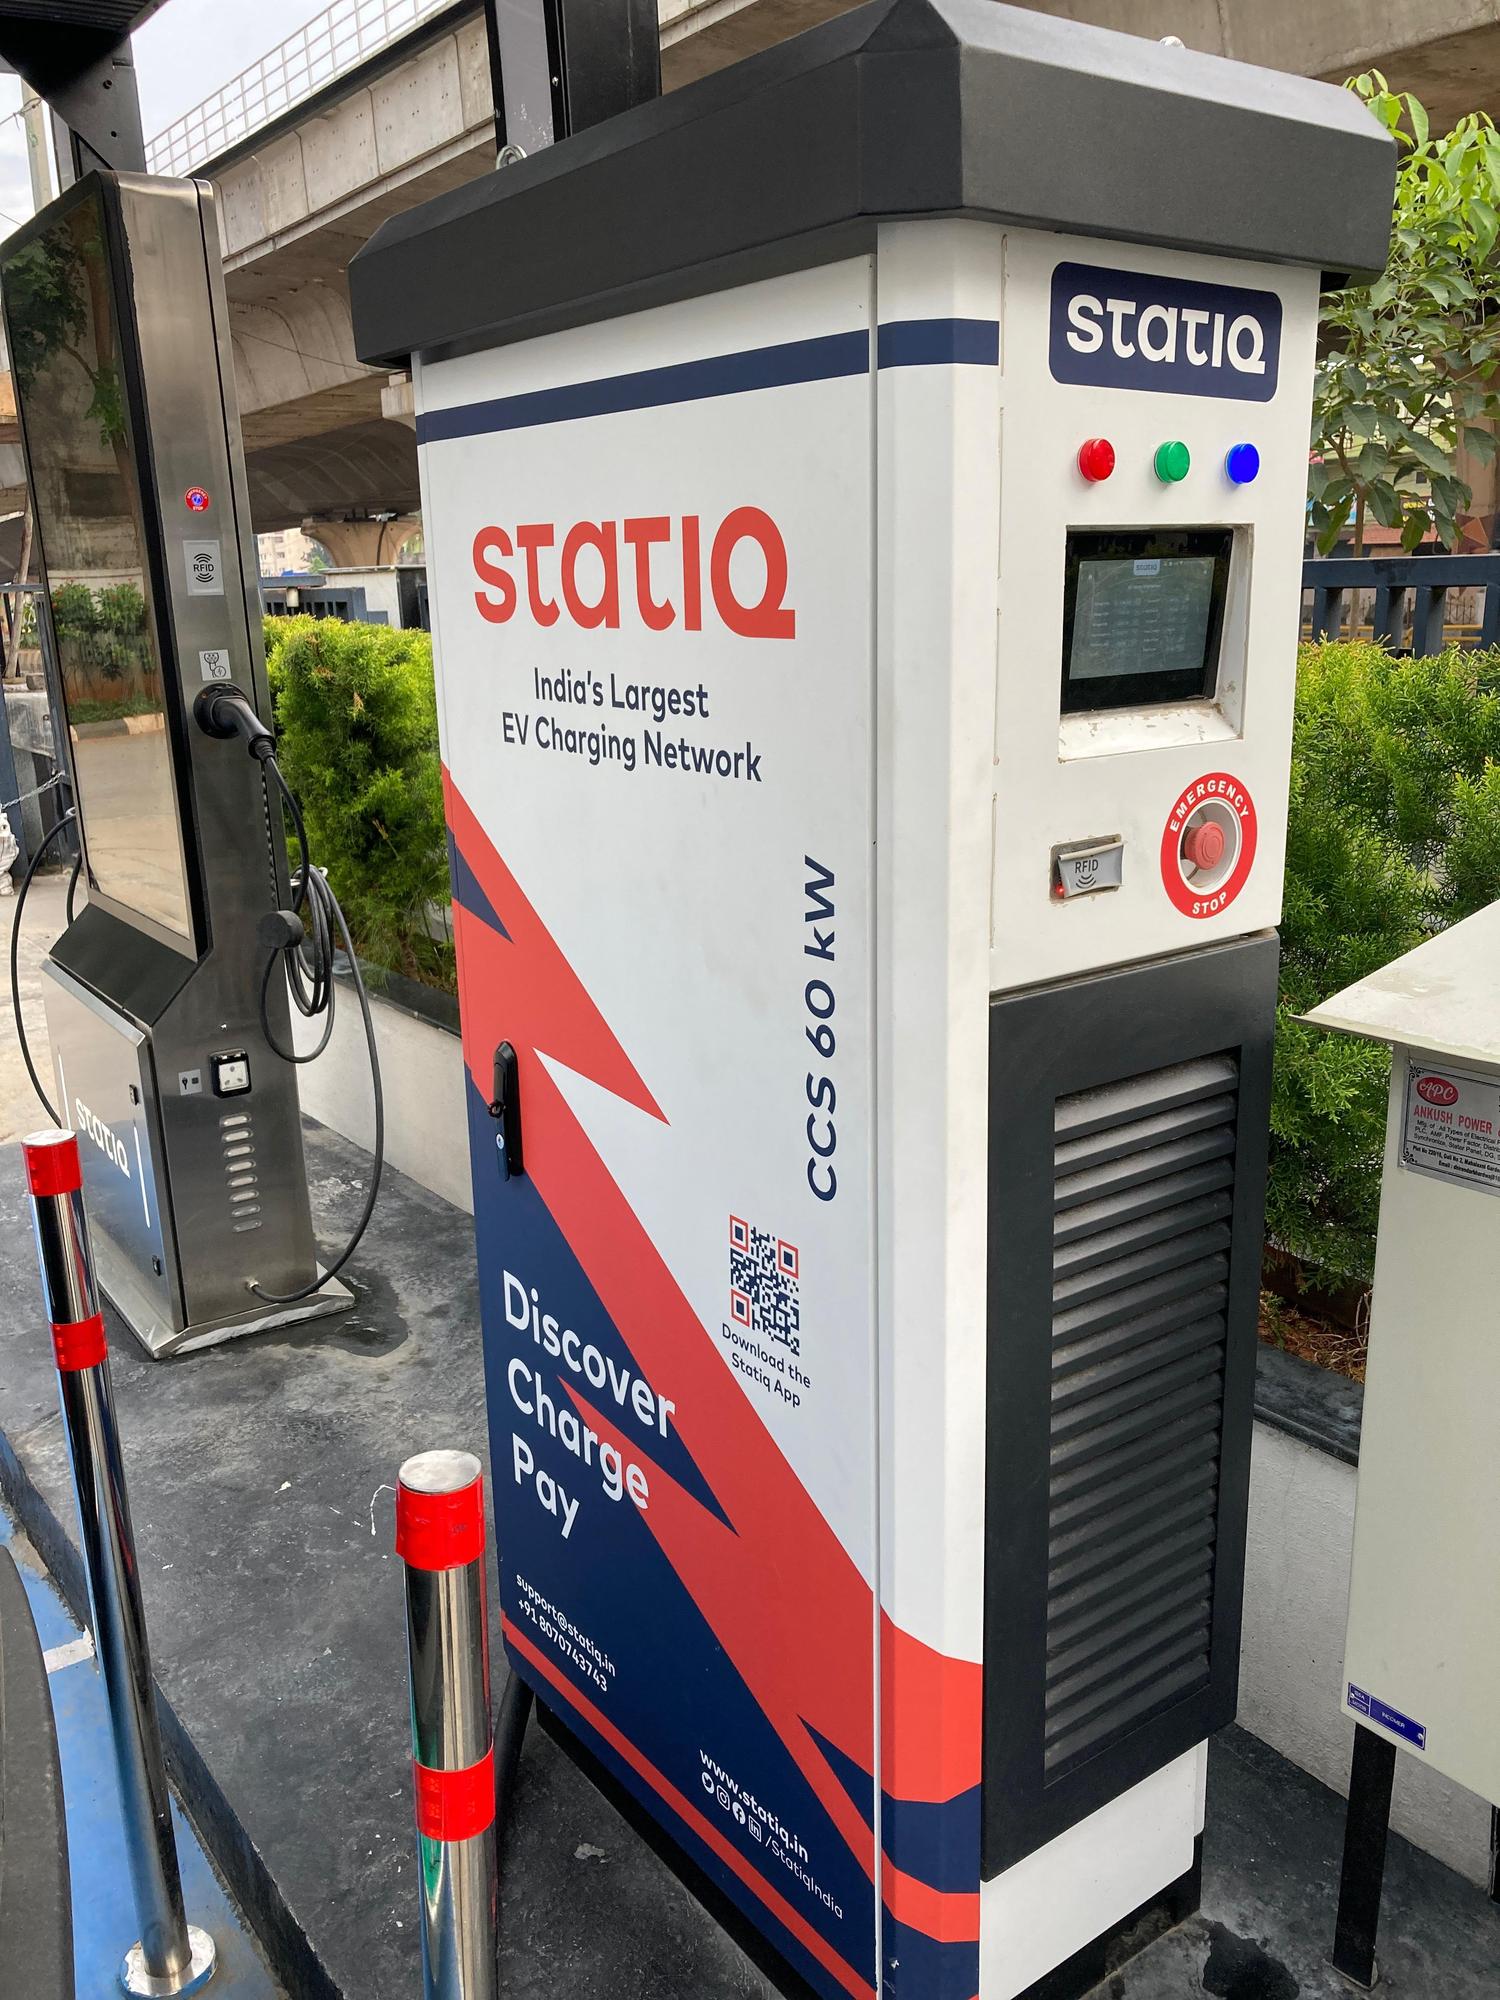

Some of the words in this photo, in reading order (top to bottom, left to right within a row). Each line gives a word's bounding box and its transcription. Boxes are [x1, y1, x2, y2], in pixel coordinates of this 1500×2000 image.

[193, 564, 215, 573] RFID
[533, 666, 604, 707] India's
[610, 672, 710, 724] Largest
[502, 711, 529, 746] EV
[535, 715, 636, 772] Charging
[643, 728, 762, 783] Network
[1169, 779, 1249, 833] EMERGENCY
[1074, 858, 1099, 874] RFID
[1192, 891, 1227, 915] STOP
[803, 854, 837, 962] kW
[804, 978, 837, 1059] 60
[805, 1071, 838, 1202] CCS
[1413, 1104, 1453, 1125] ANKUSH
[1458, 1115, 1493, 1135] POWER
[503, 1269, 676, 1438] Discover
[722, 1322, 785, 1374] Download
[788, 1364, 811, 1389] the
[731, 1352, 771, 1393] Statiq
[773, 1379, 801, 1408] App
[507, 1357, 650, 1510] Charge
[512, 1432, 580, 1540] Pay
[516, 1574, 616, 1678] support@statiq.in
[518, 1599, 538, 1625] +91
[539, 1615, 608, 1692] 8070743743
[700, 1749, 809, 1864] www.statiq.in
